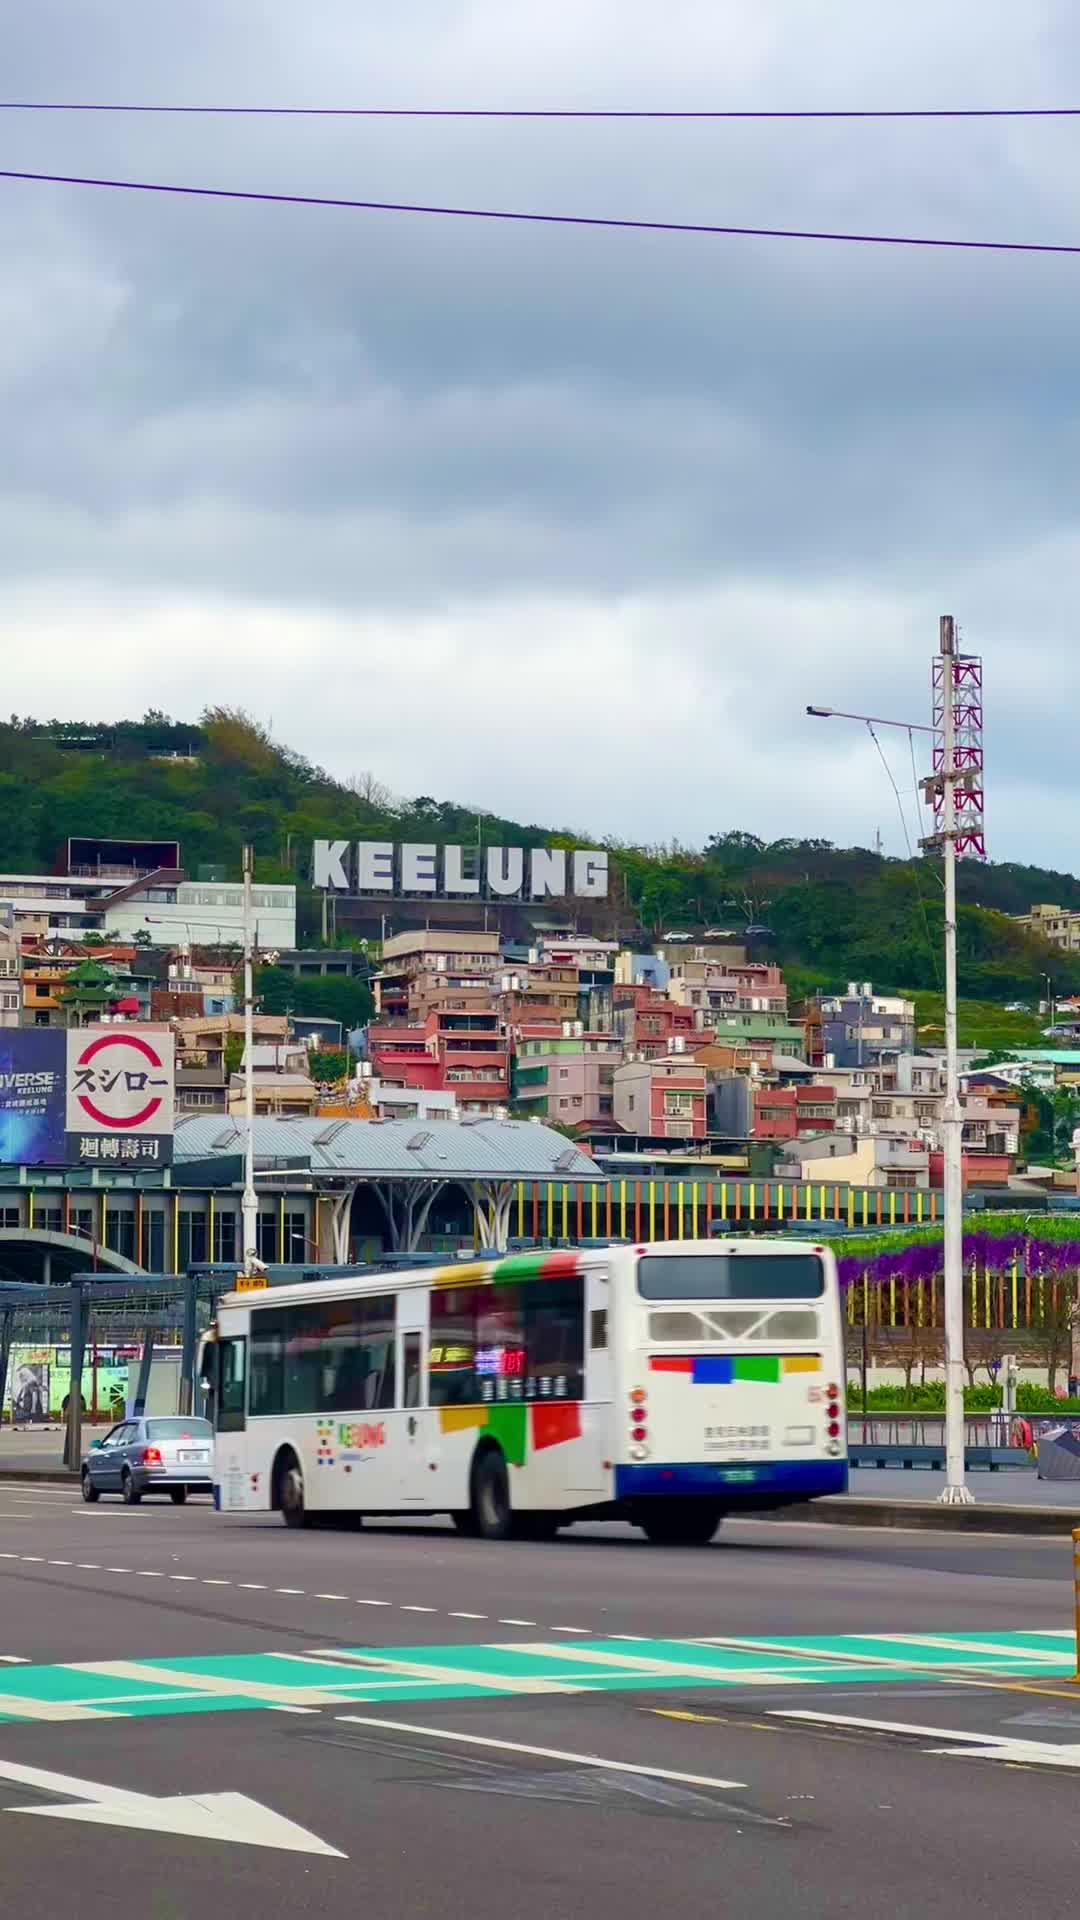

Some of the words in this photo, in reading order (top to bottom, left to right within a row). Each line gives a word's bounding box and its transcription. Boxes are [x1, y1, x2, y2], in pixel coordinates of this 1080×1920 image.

[313, 840, 608, 897] KEELUNG
[17, 1086, 53, 1094] KEELUNG
[71, 1069, 168, 1092] スシロー
